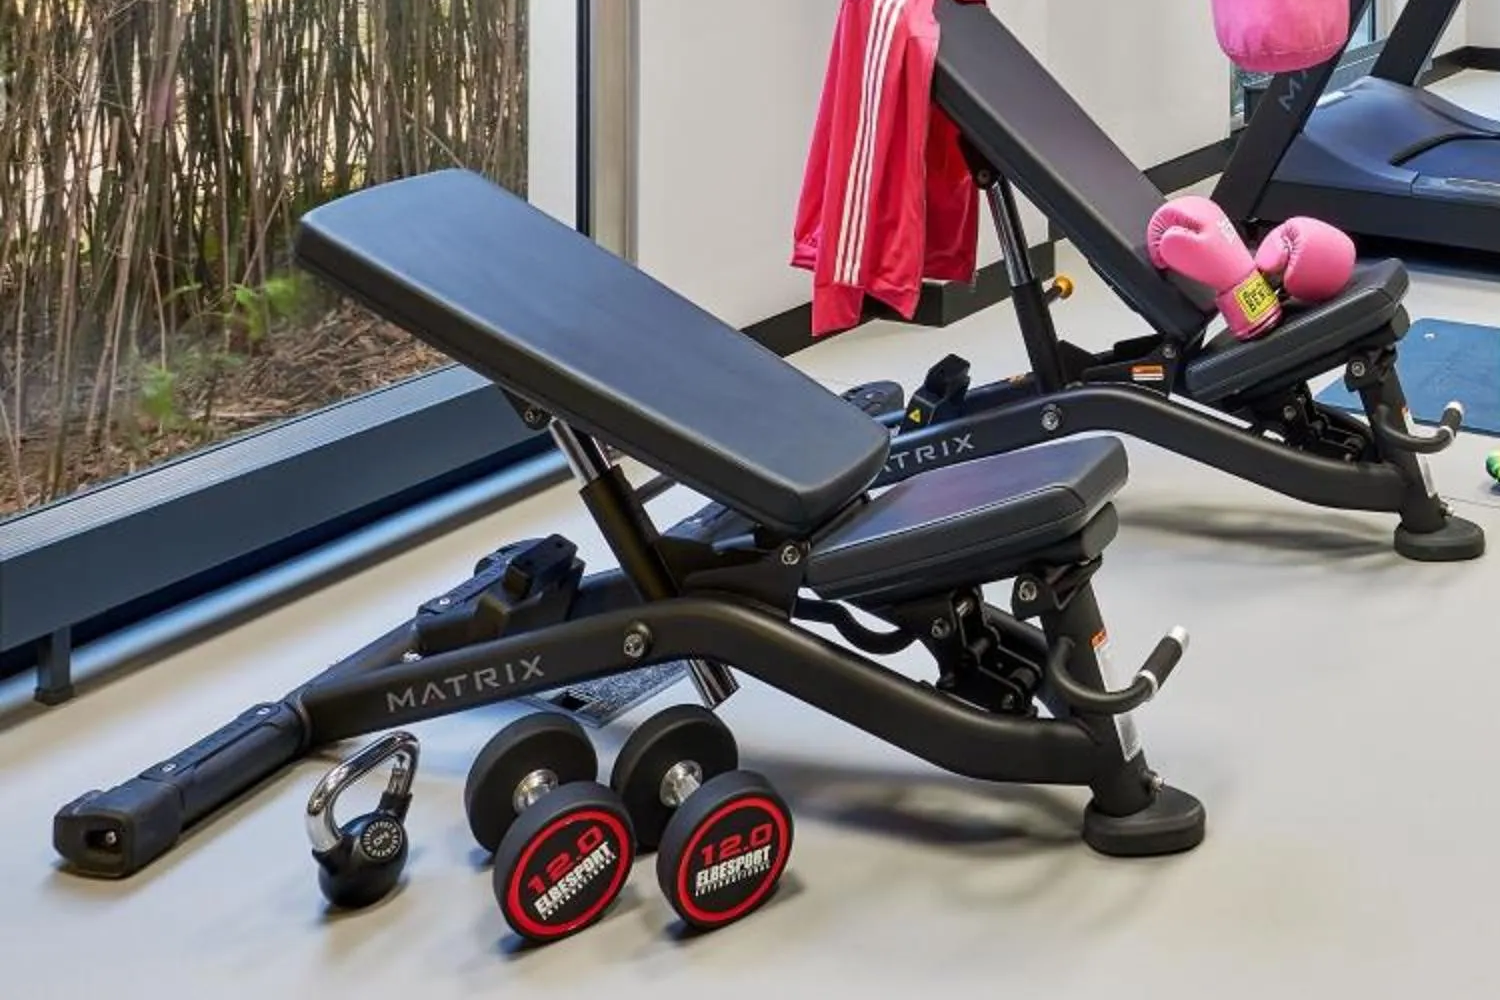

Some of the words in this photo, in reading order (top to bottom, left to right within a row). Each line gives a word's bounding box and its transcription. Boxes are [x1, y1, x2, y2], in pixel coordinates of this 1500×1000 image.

[882, 433, 975, 472] TRIX
[386, 655, 544, 713] MATRIX
[528, 826, 604, 895] 12.0
[696, 844, 771, 888] ELBESPORT
[702, 823, 773, 867] 12.0
[534, 841, 613, 914] ELBESPORT
